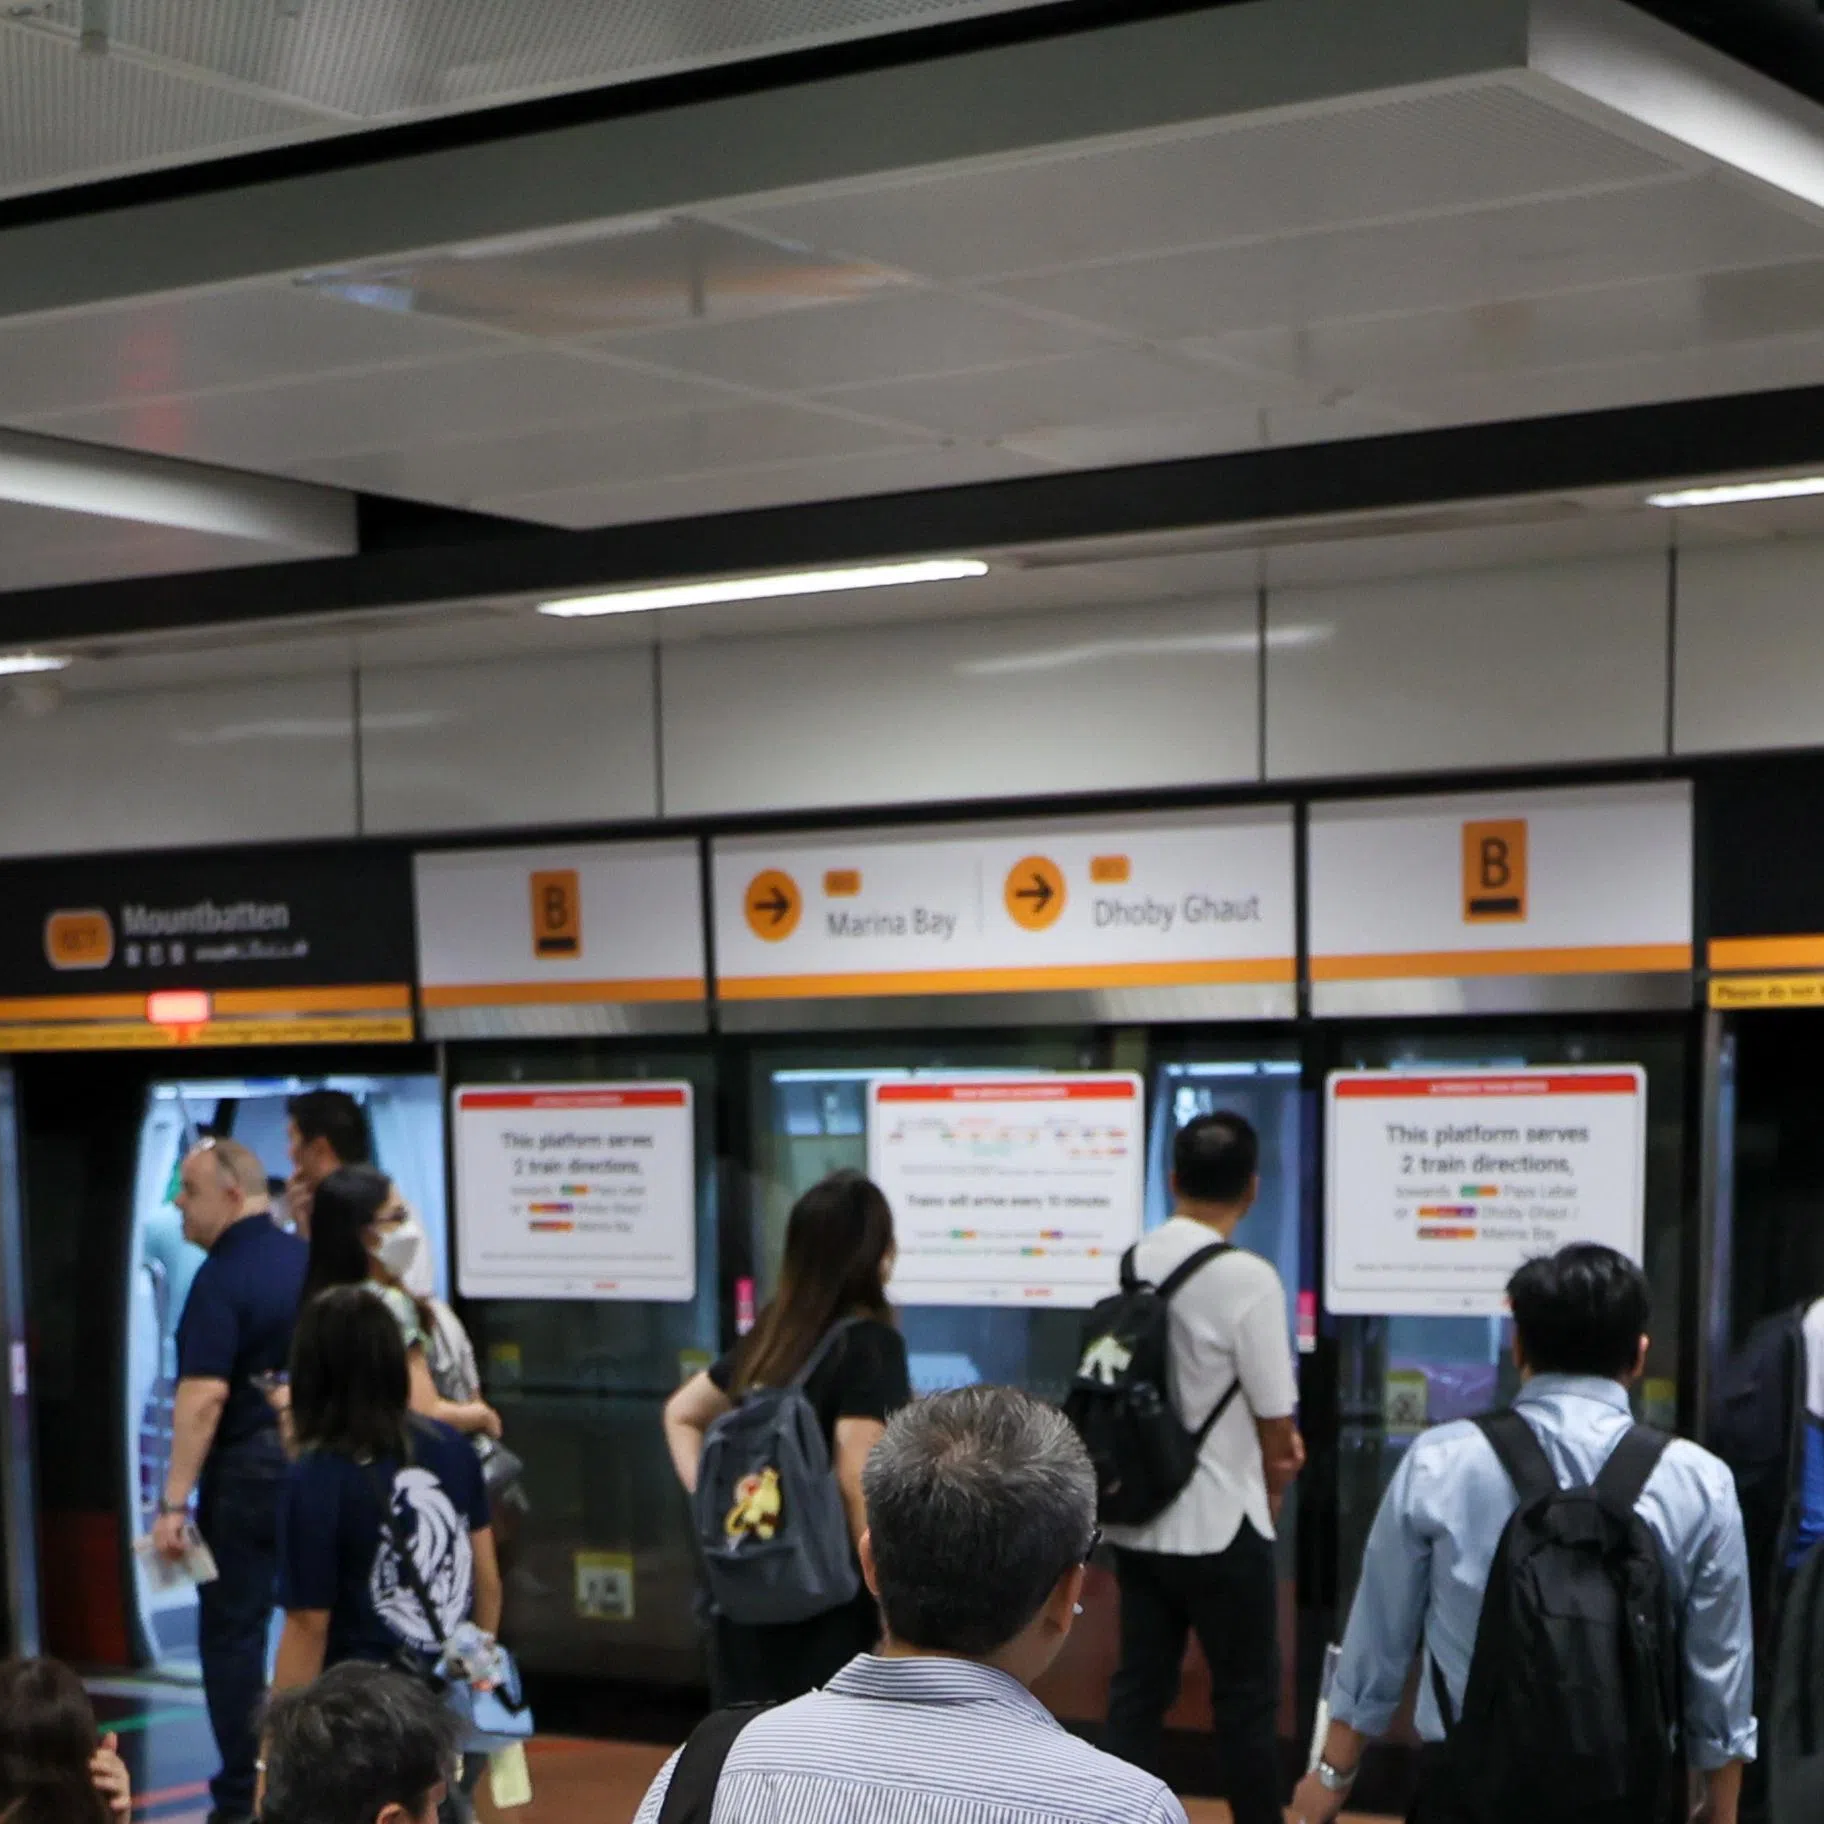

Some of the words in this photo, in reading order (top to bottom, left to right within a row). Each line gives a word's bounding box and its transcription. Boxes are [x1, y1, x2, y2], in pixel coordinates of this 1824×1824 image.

[1480, 836, 1511, 889] B
[123, 899, 290, 935] Mountbatten
[544, 884, 567, 930] B
[828, 911, 908, 937] Marina
[914, 907, 957, 941] Bay
[1095, 896, 1174, 932] Dhoby
[1184, 894, 1262, 924] Ghaut
[1386, 1124, 1428, 1144] This
[1435, 1122, 1520, 1149] platform
[1526, 1126, 1590, 1144] serves
[1401, 1154, 1415, 1175] 2
[1420, 1154, 1466, 1174] train
